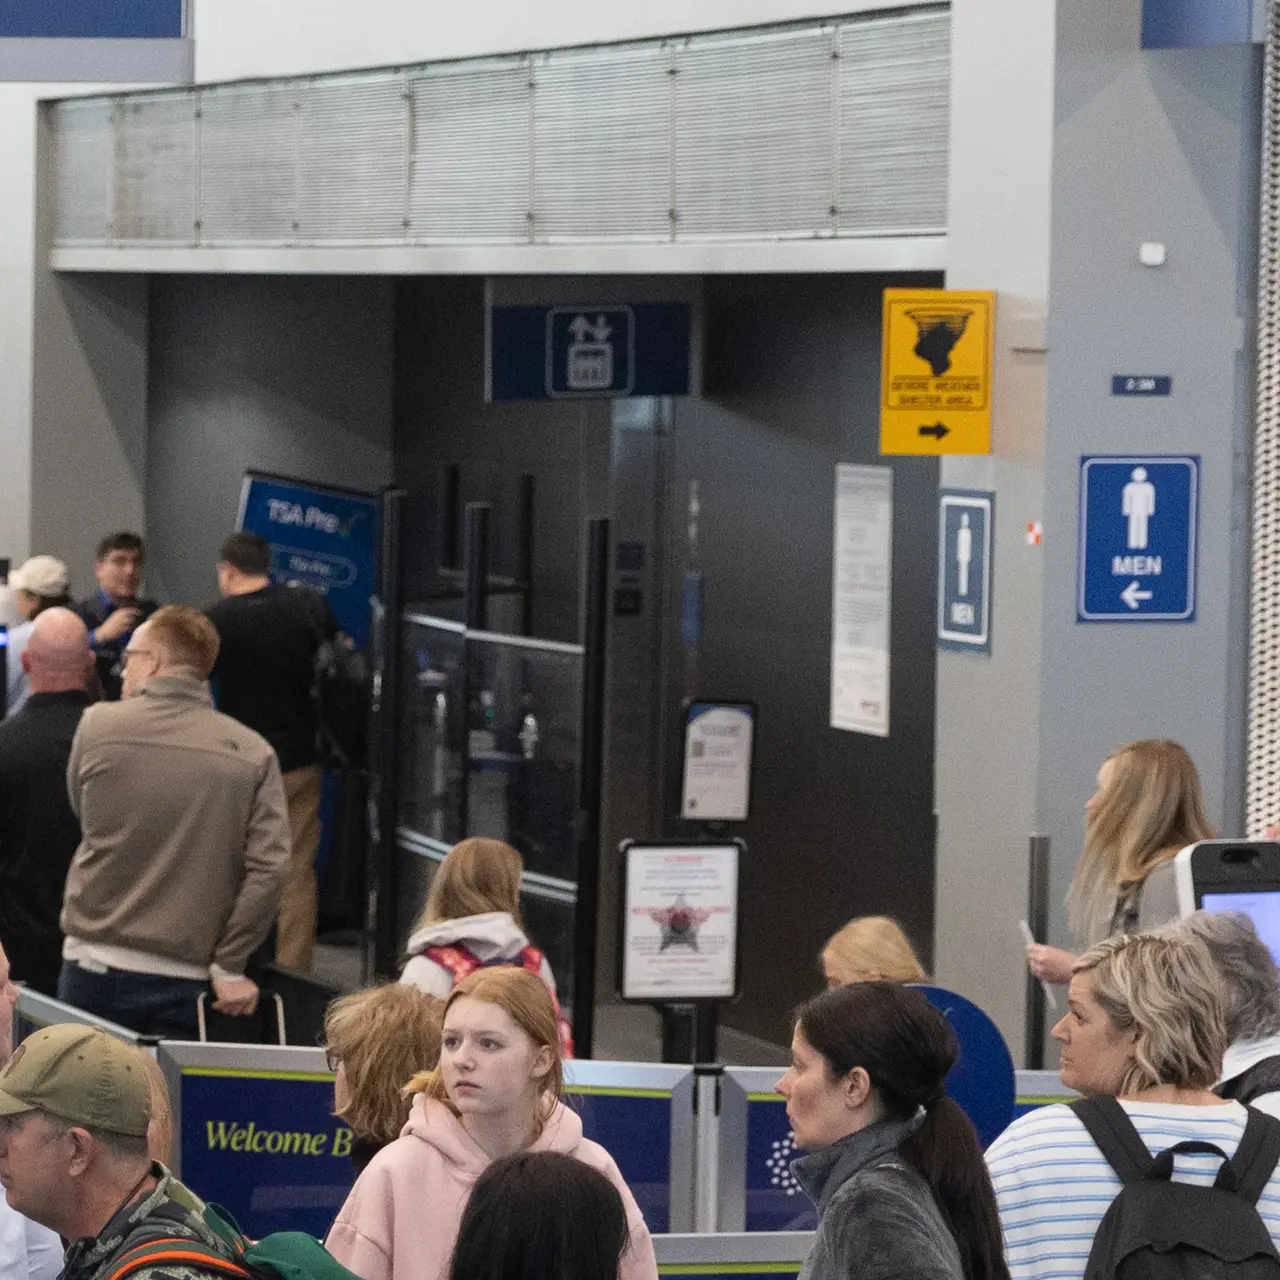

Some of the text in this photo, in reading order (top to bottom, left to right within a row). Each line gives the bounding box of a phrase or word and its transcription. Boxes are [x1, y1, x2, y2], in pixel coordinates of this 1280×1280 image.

[267, 498, 304, 527] TSA
[1112, 555, 1162, 575] MEN
[205, 1120, 328, 1156] Welcome
